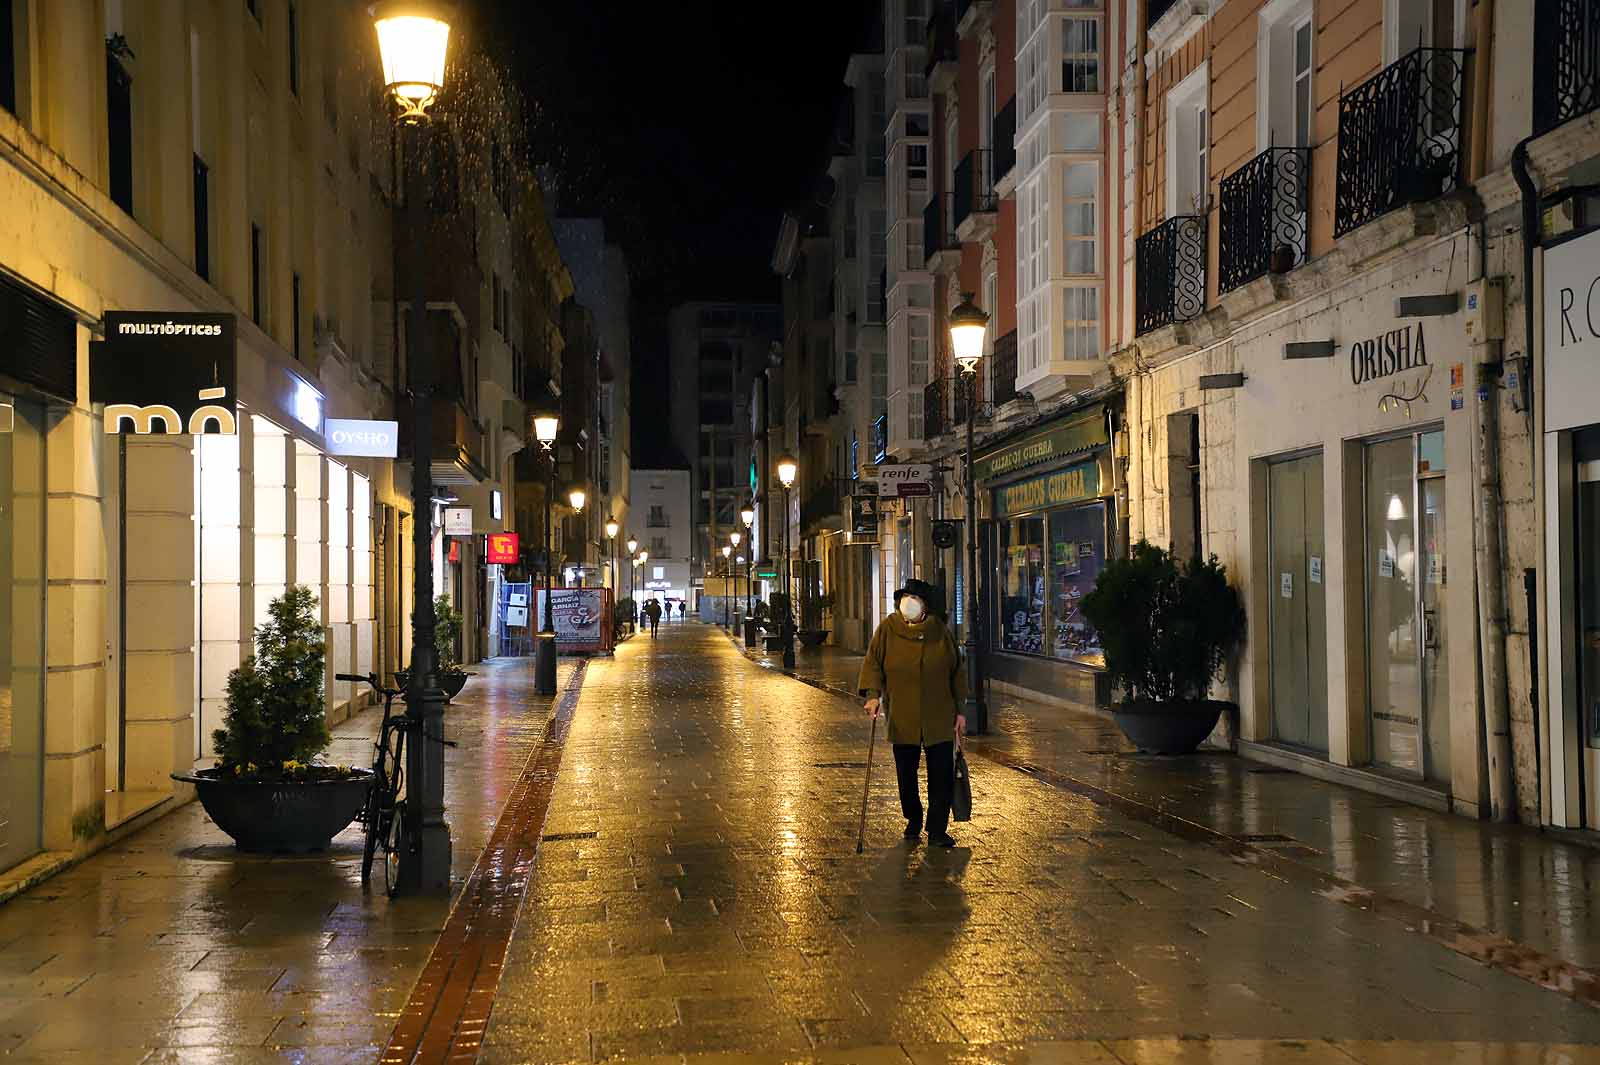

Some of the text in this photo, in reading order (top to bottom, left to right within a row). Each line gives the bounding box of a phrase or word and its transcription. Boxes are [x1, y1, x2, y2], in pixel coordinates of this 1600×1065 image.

[1350, 321, 1428, 386] ORISHA
[332, 430, 389, 449] OYSHO
[1023, 439, 1053, 461] GUERRA
[882, 467, 920, 482] renfe
[1048, 468, 1085, 501] GUERRA
